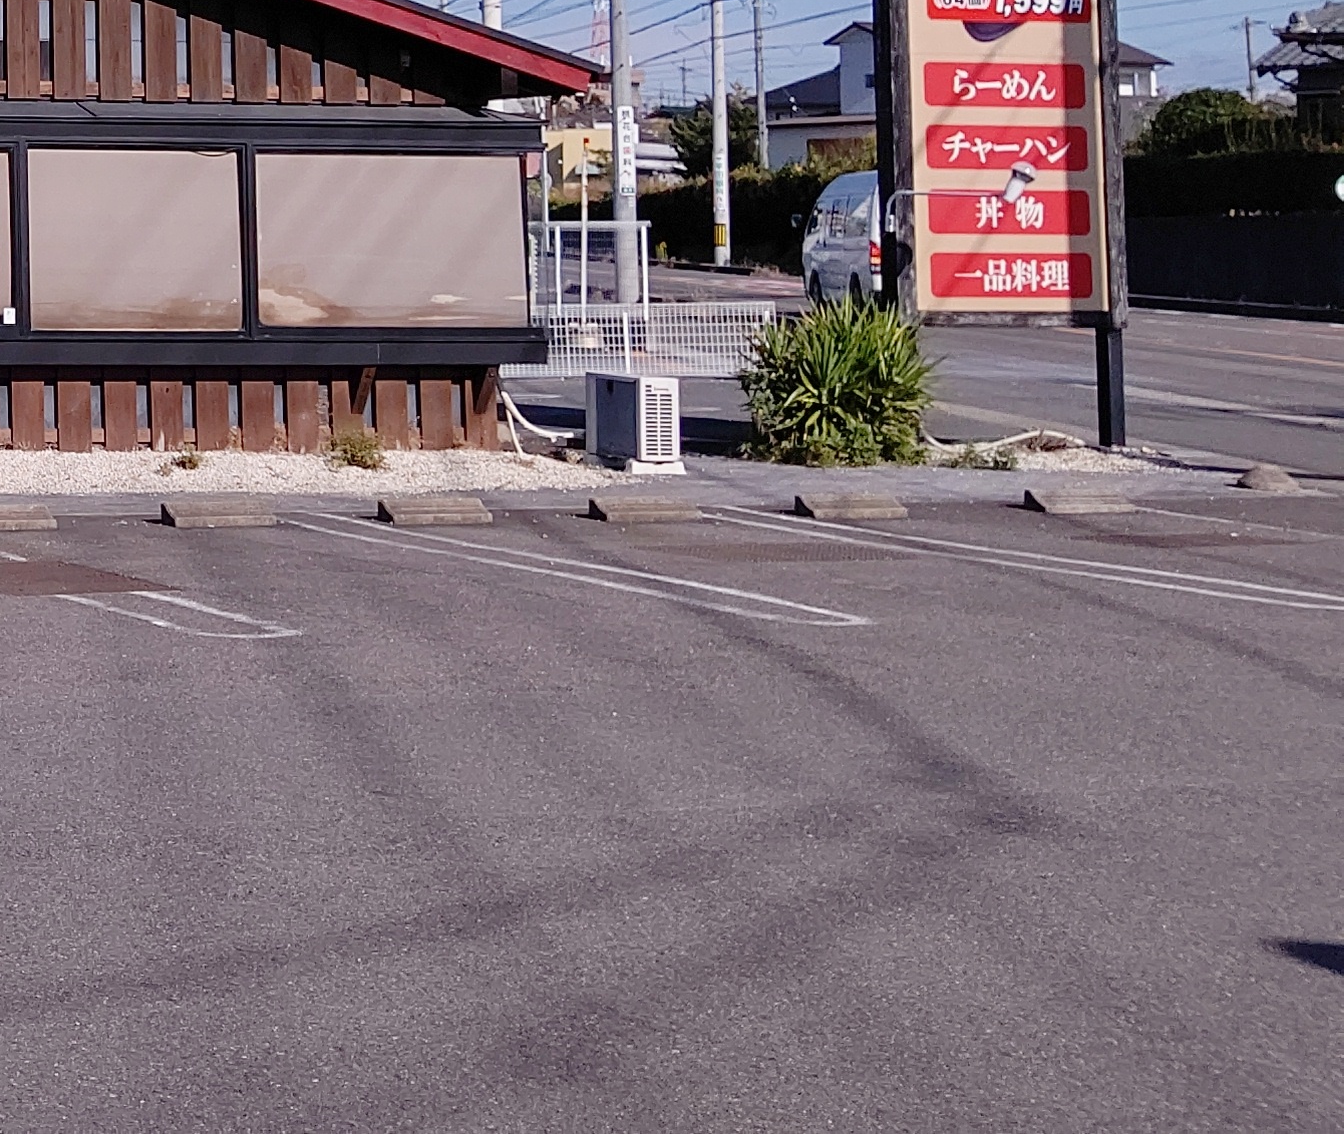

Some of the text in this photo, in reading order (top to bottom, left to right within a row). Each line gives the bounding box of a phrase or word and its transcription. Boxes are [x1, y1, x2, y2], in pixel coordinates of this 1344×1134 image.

[953, 68, 1056, 101] らーめん
[942, 131, 1071, 164] チャーハン
[954, 259, 1070, 292] 一品料理
